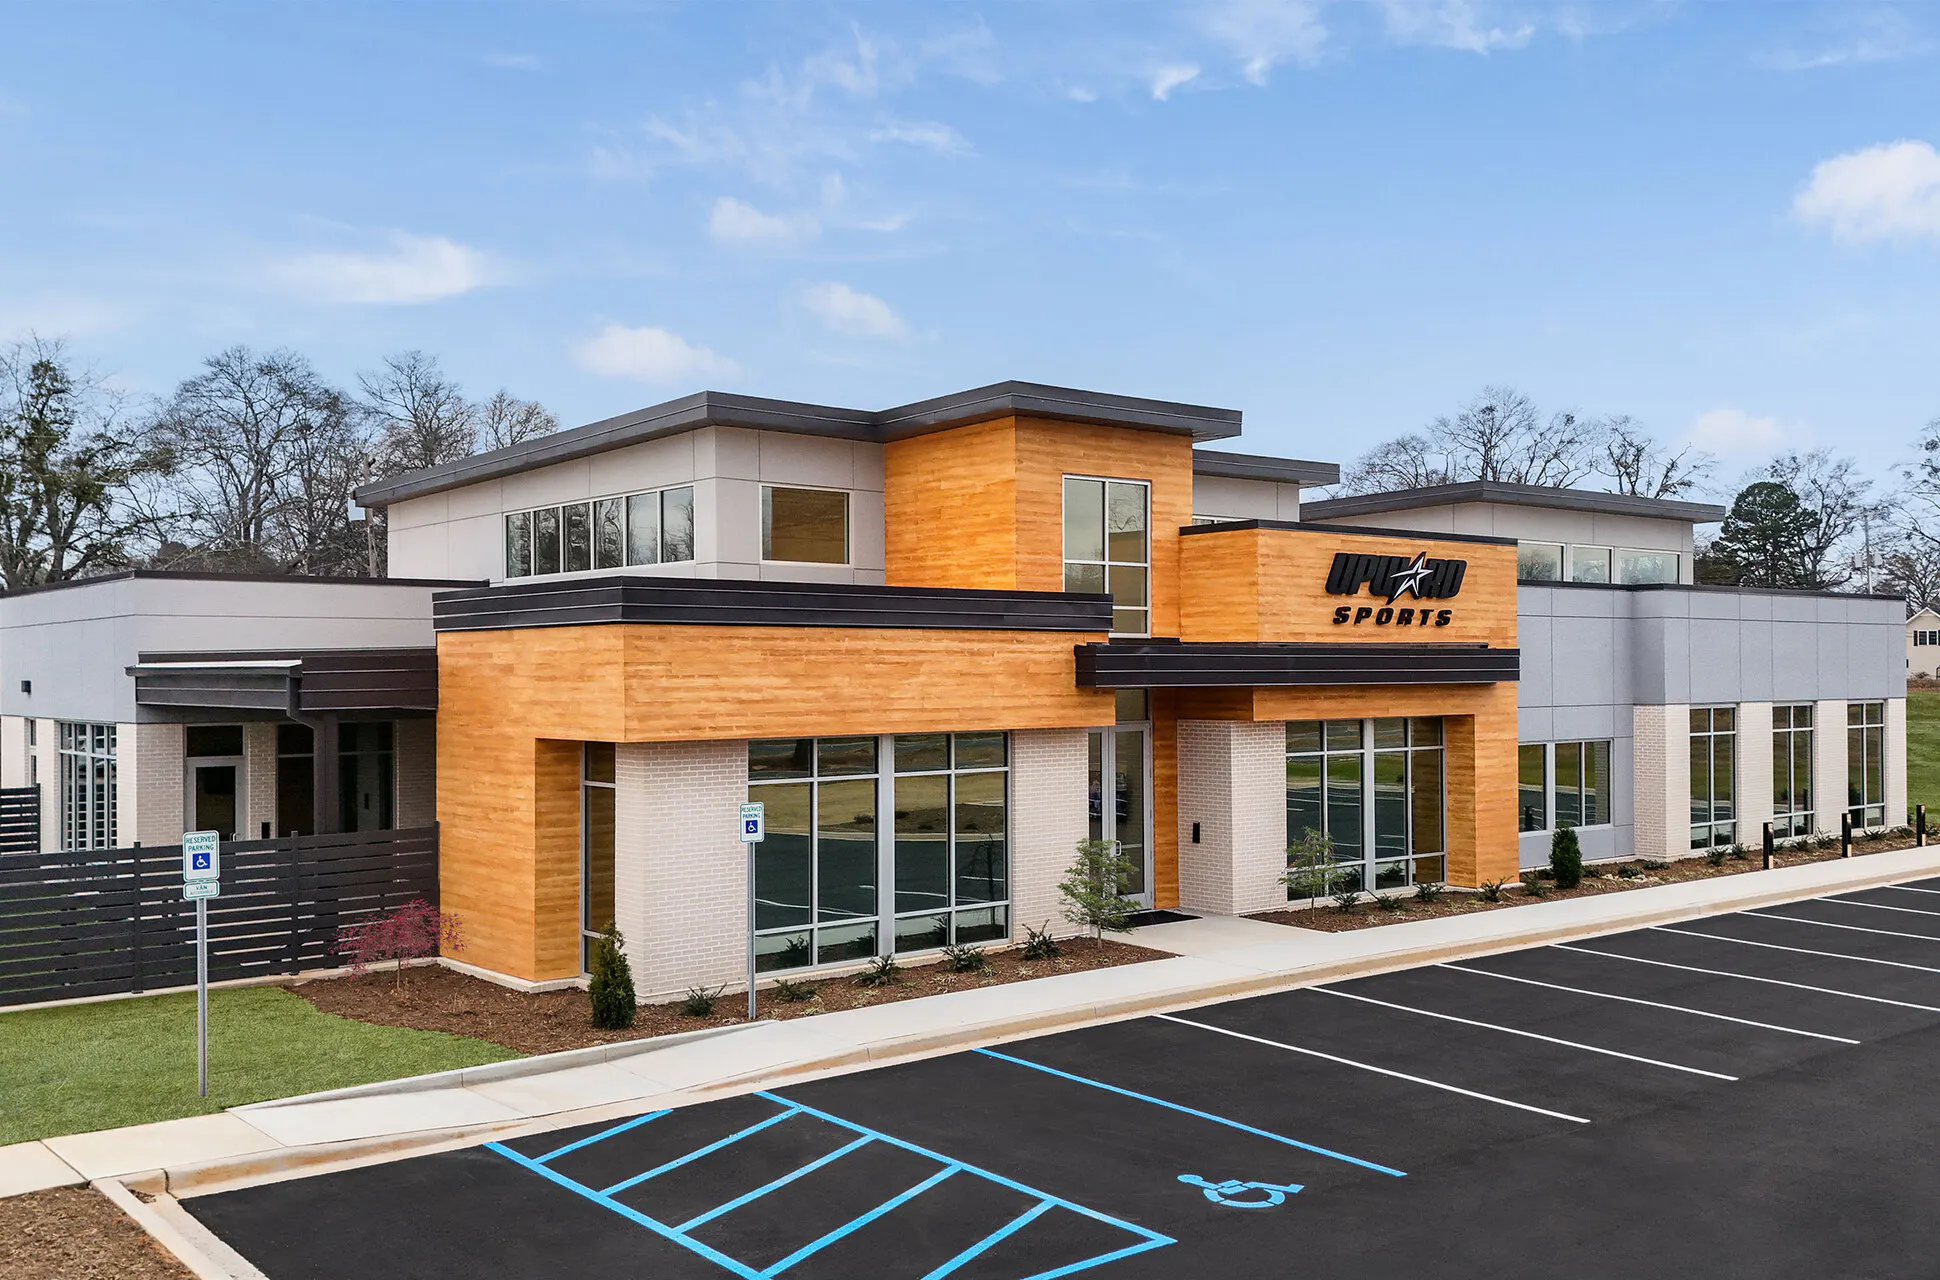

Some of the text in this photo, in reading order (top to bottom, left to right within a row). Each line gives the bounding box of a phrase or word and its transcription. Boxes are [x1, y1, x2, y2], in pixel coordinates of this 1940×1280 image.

[1332, 606, 1453, 627] SPORTS
[185, 835, 216, 844] RESERVED
[188, 844, 214, 852] PARKING
